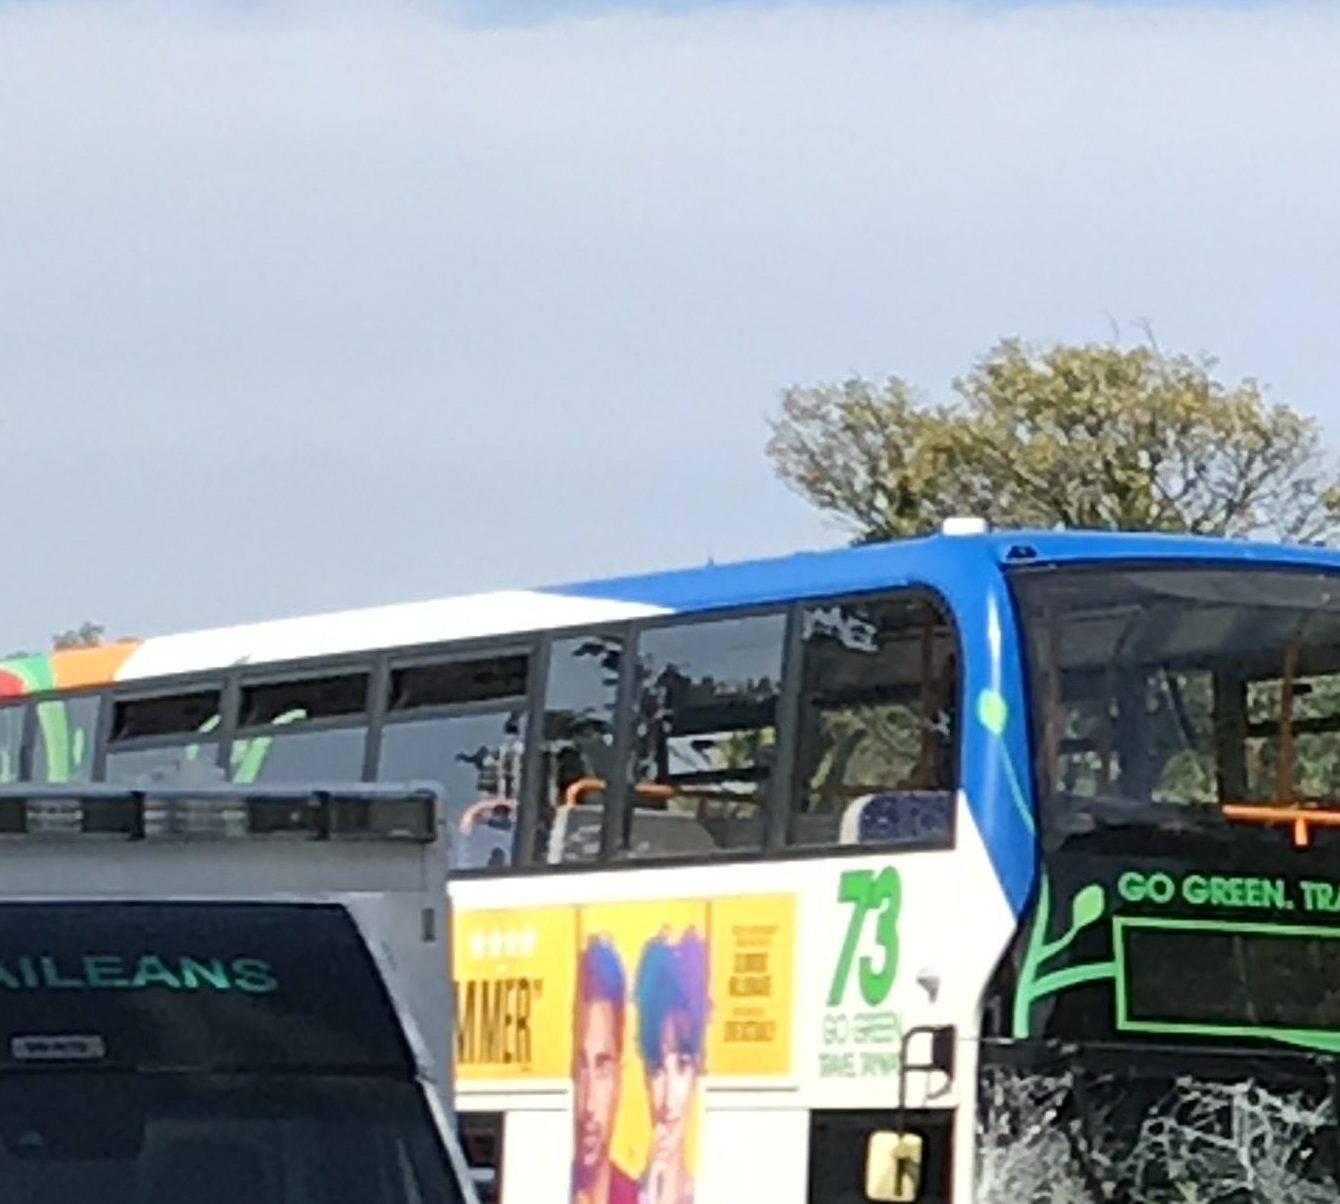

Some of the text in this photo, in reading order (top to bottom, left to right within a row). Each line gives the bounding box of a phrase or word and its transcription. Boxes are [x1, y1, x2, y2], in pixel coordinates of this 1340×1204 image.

[1117, 871, 1175, 903] GO
[1182, 874, 1294, 910] GREEN.
[826, 866, 902, 1007] 73
